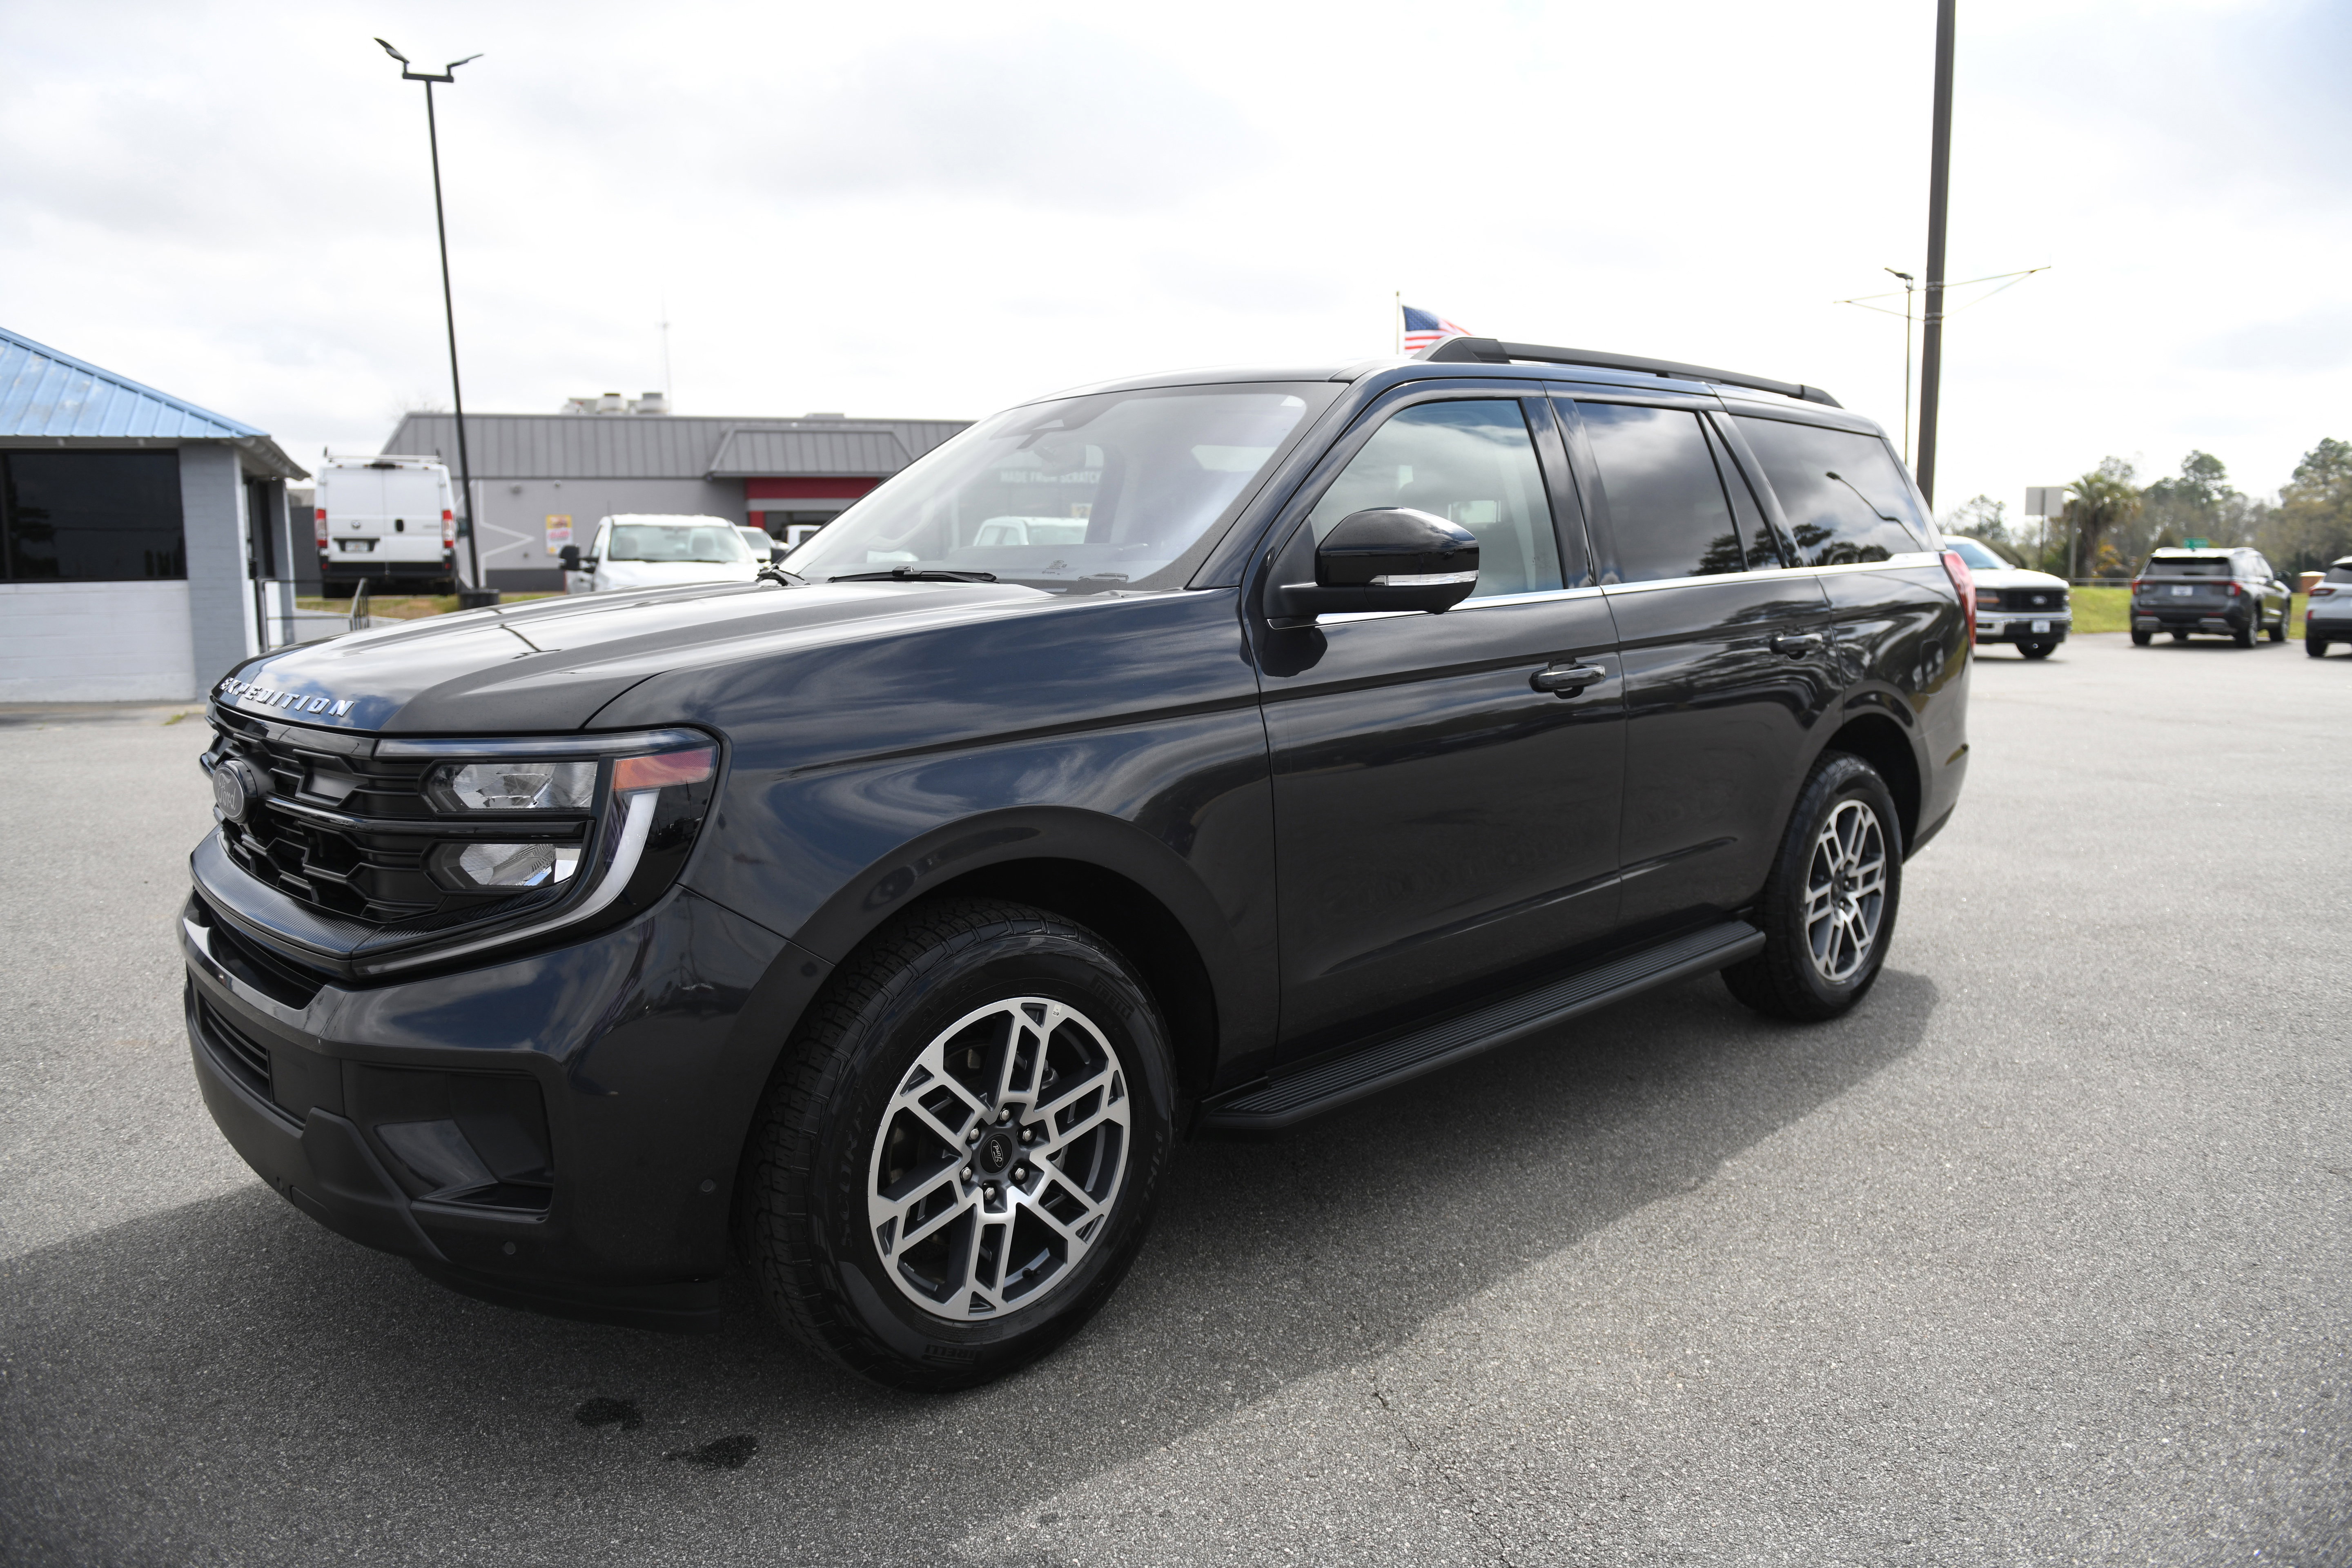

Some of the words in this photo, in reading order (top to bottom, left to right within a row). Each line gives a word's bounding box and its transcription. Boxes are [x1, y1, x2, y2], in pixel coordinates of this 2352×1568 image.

[220, 677, 354, 717] EXPEDITION
[217, 773, 237, 812] Ford
[1089, 973, 1135, 1021] PIRELLI
[837, 1034, 904, 1248] SCORPION
[993, 1144, 1002, 1162] Ford
[922, 1343, 984, 1365] PIRELLI
